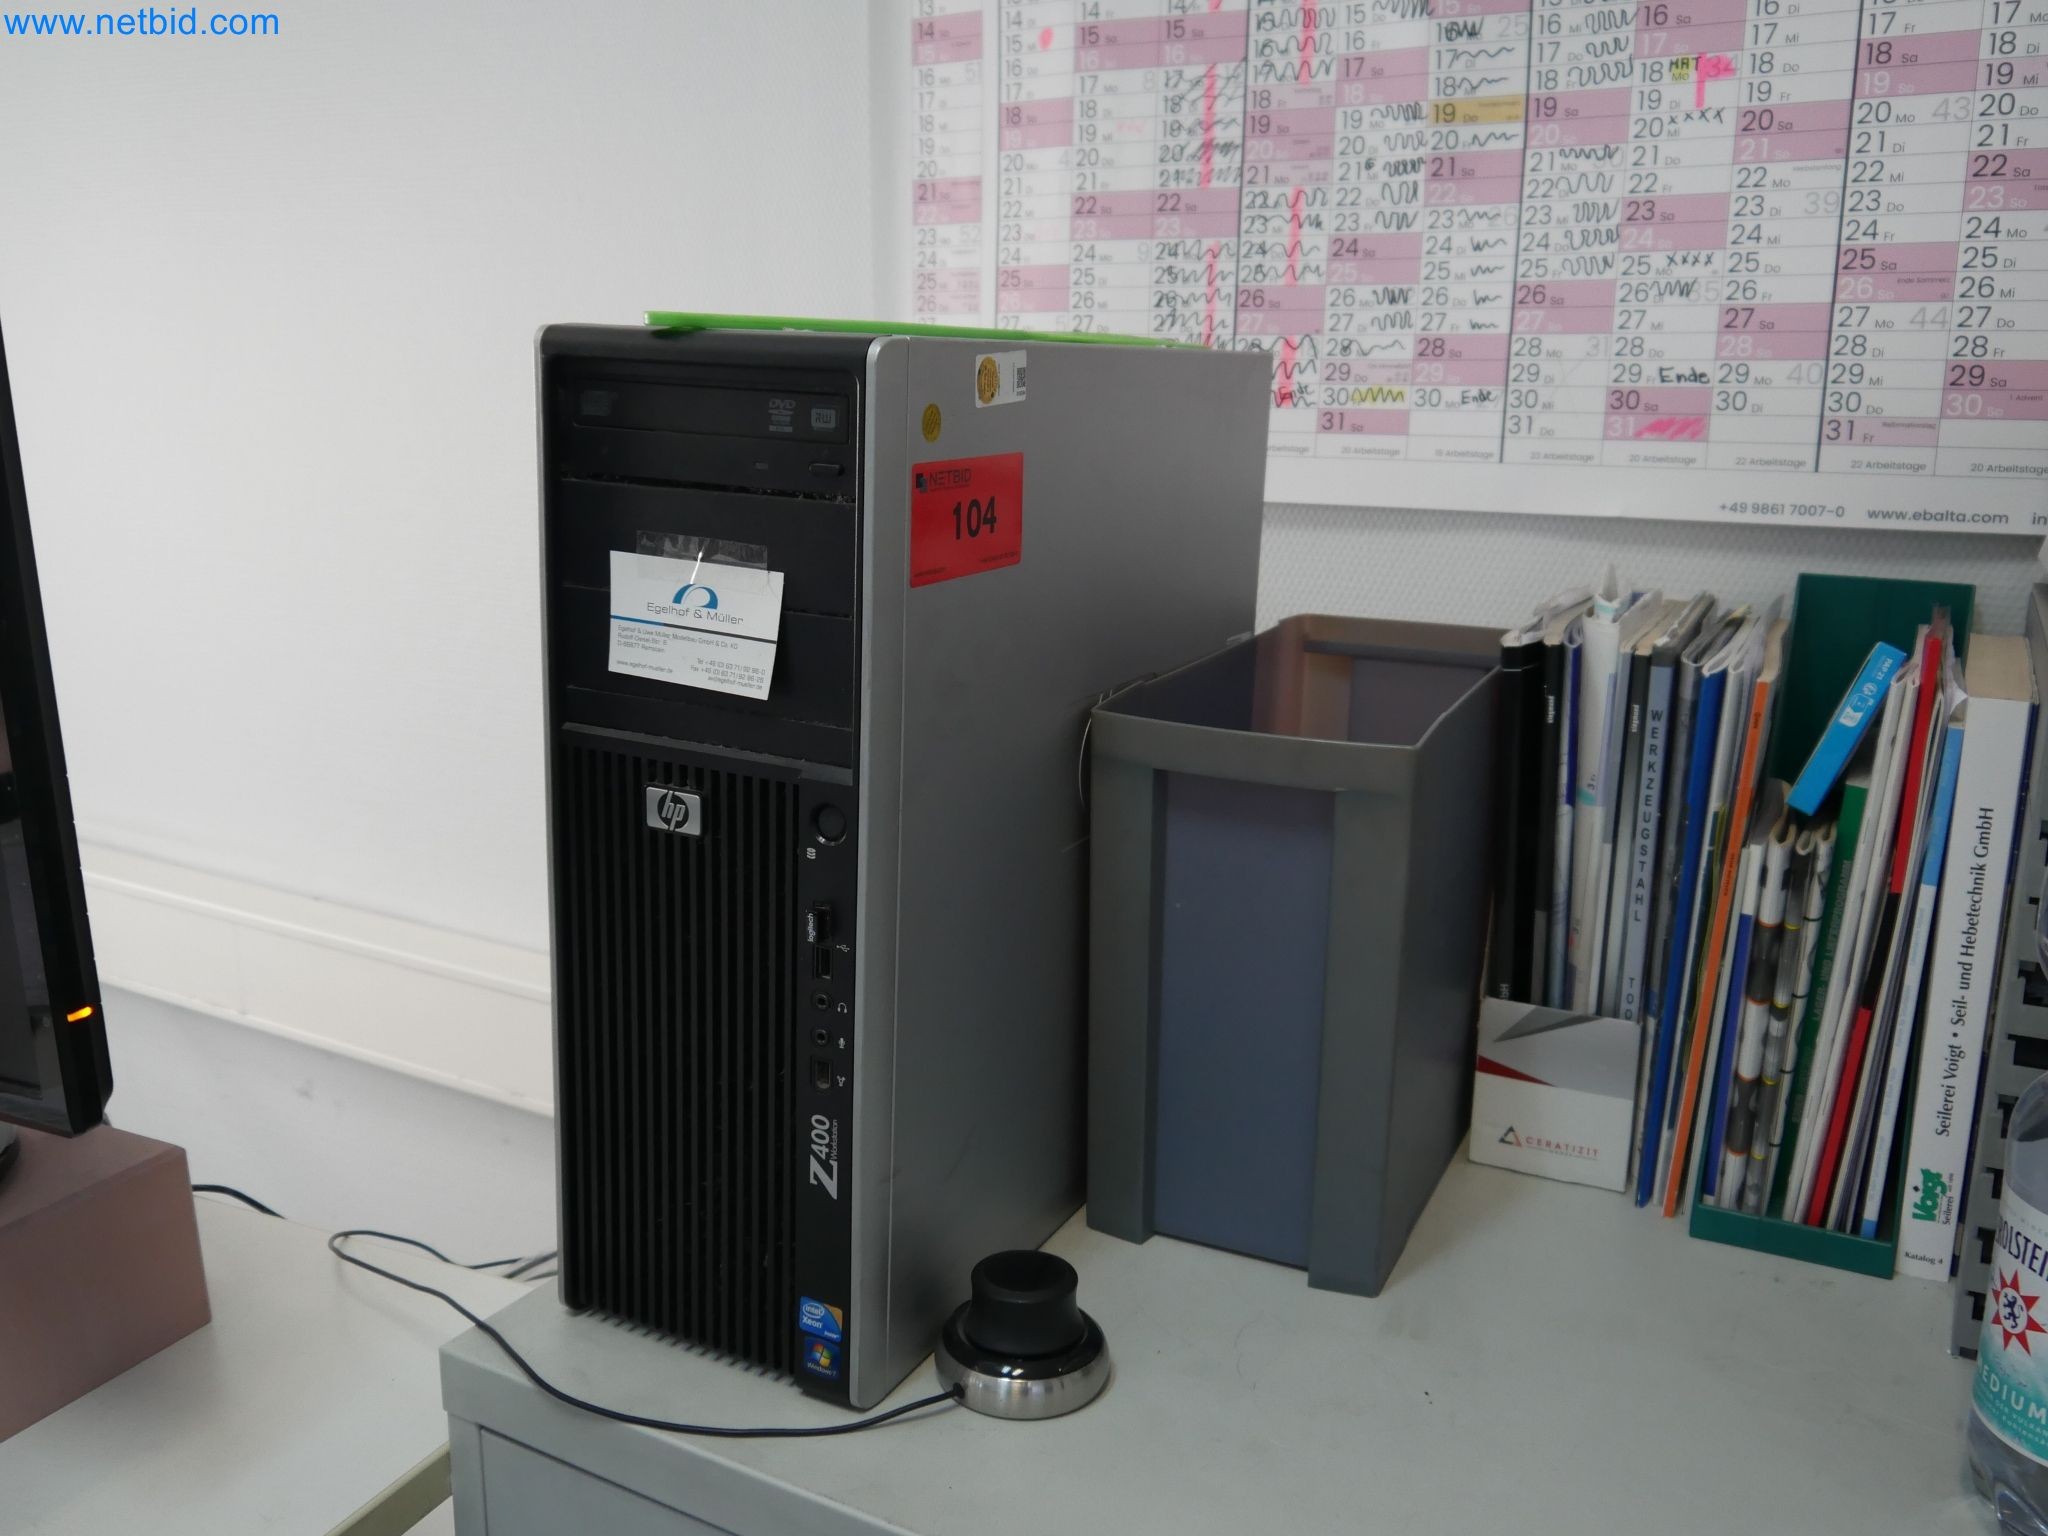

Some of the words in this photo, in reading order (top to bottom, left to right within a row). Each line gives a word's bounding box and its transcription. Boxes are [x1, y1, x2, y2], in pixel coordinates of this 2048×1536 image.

[1869, 12, 1896, 34] 17
[1905, 22, 1916, 33] Fr
[1993, 1, 2020, 24] 17
[918, 23, 934, 39] 14
[1080, 26, 1099, 43] 15
[1166, 20, 1185, 39] 15
[1753, 22, 1778, 44] 17
[1786, 32, 1800, 43] Mi
[1867, 42, 1892, 64] 18
[1902, 52, 1917, 63] Sa
[1990, 31, 2017, 54] 18
[2027, 42, 2040, 53] Di
[1344, 57, 1364, 77] 17
[1371, 66, 1383, 76] Sa
[1986, 62, 2014, 86] 19
[2024, 73, 2039, 85] Mi
[1002, 107, 1021, 124] 18
[1433, 104, 1456, 123] 19
[1463, 113, 1478, 122] Do
[1534, 98, 1557, 117] 19
[1565, 107, 1578, 117] Sa
[1857, 102, 1891, 123] 20
[1896, 112, 1915, 123] Mo
[1980, 94, 2015, 116] 20
[2020, 105, 2039, 116] Do
[1742, 109, 1774, 131] 20
[1778, 120, 1793, 131] Sa
[1856, 132, 1886, 152] 21
[1893, 142, 1905, 152] Di
[1978, 124, 2008, 147] 21
[2017, 135, 2028, 147] Fr
[1432, 157, 1456, 177] 21
[1462, 167, 1475, 176] Sa
[1852, 161, 1883, 182] 22
[1890, 171, 1904, 182] Mi
[1973, 154, 2006, 177] 22
[2014, 167, 2030, 178] Sa
[918, 184, 937, 200] 21
[1075, 197, 1096, 214] 22
[1157, 194, 1181, 212] 22
[1734, 195, 1764, 216] 23
[1770, 206, 1781, 216] Di
[1846, 219, 1879, 241] 24
[1884, 231, 1895, 241] Fr
[1966, 217, 2001, 238] 24
[2007, 228, 2027, 238] Mo
[1332, 238, 1359, 258] 24
[1362, 249, 1375, 258] Sa
[1963, 247, 1997, 269] 25
[2004, 258, 2016, 268] Di
[1728, 252, 1760, 273] 25
[1764, 263, 1781, 273] Do
[1842, 248, 1875, 270] 25
[1881, 260, 1896, 271] Sa
[1001, 270, 1020, 288] 25
[1073, 268, 1096, 285] 25
[1518, 285, 1546, 305] 26
[1550, 296, 1564, 306] Sa
[1959, 277, 1994, 298] 26
[2000, 288, 2015, 298] Mi
[1239, 290, 1264, 308] 26
[1724, 308, 1754, 329] 27
[1760, 320, 1775, 330] Sa
[1837, 306, 1870, 328] 27
[1875, 319, 1894, 329] Mo
[1957, 306, 1992, 328] 27
[1997, 318, 2014, 328] Do
[1418, 338, 1445, 357] 28
[1450, 348, 1462, 358] Sa
[1834, 335, 1867, 356] 28
[1872, 348, 1884, 358] Di
[1953, 336, 1988, 357] 28
[1994, 348, 2005, 357] Fr
[1659, 366, 1710, 384] Ende
[1718, 363, 1750, 384] 29
[1754, 375, 1772, 385] Mo
[1831, 363, 1864, 384] 29
[1869, 376, 1883, 386] Mi
[1950, 365, 1985, 386] 29
[1990, 377, 2006, 388] Sa
[769, 399, 796, 408] DVD
[1415, 389, 1441, 407] 30
[1461, 390, 1497, 404] Ende
[1611, 390, 1640, 410] 30
[1644, 403, 1658, 412] Sa
[1828, 392, 1861, 412] 30
[1866, 405, 1883, 415] Do
[1322, 413, 1344, 430] 31
[1352, 423, 1363, 432] Sa
[1826, 420, 1854, 441] 31
[1863, 433, 1874, 442] Fr
[1750, 458, 1806, 469] Arbeitstage
[1851, 460, 1863, 469] 22
[1866, 460, 1926, 472] Arbeitstage
[1971, 463, 1983, 472] 20
[929, 468, 972, 486] NETBID
[953, 495, 997, 540] 104
[1720, 502, 1747, 514] +49
[1751, 502, 1786, 516] 9861
[1789, 505, 1845, 518] 7007-0
[1867, 508, 2009, 525] www.ebalta.com
[647, 602, 690, 618] Egelhof
[694, 609, 702, 618] &
[707, 611, 743, 625] Müller
[662, 791, 686, 831] hp
[1632, 709, 1664, 922] WERKZEUGSTAHL
[1973, 807, 1994, 858] GmbH
[1960, 859, 1987, 957] Hebetechnik
[808, 913, 816, 942] logitech
[1959, 961, 1972, 989] und
[1951, 996, 1967, 1026] Seil-
[1944, 1050, 1966, 1086] Voigt
[1935, 1088, 1954, 1137] Seilerei
[810, 1114, 838, 1200] Z400
[1525, 1136, 1600, 1157] CERATIZIT
[1912, 1168, 1948, 1222] Voigt
[1904, 1251, 1935, 1266] Katalog
[806, 1305, 822, 1315] intel
[802, 1315, 822, 1328] Xeon
